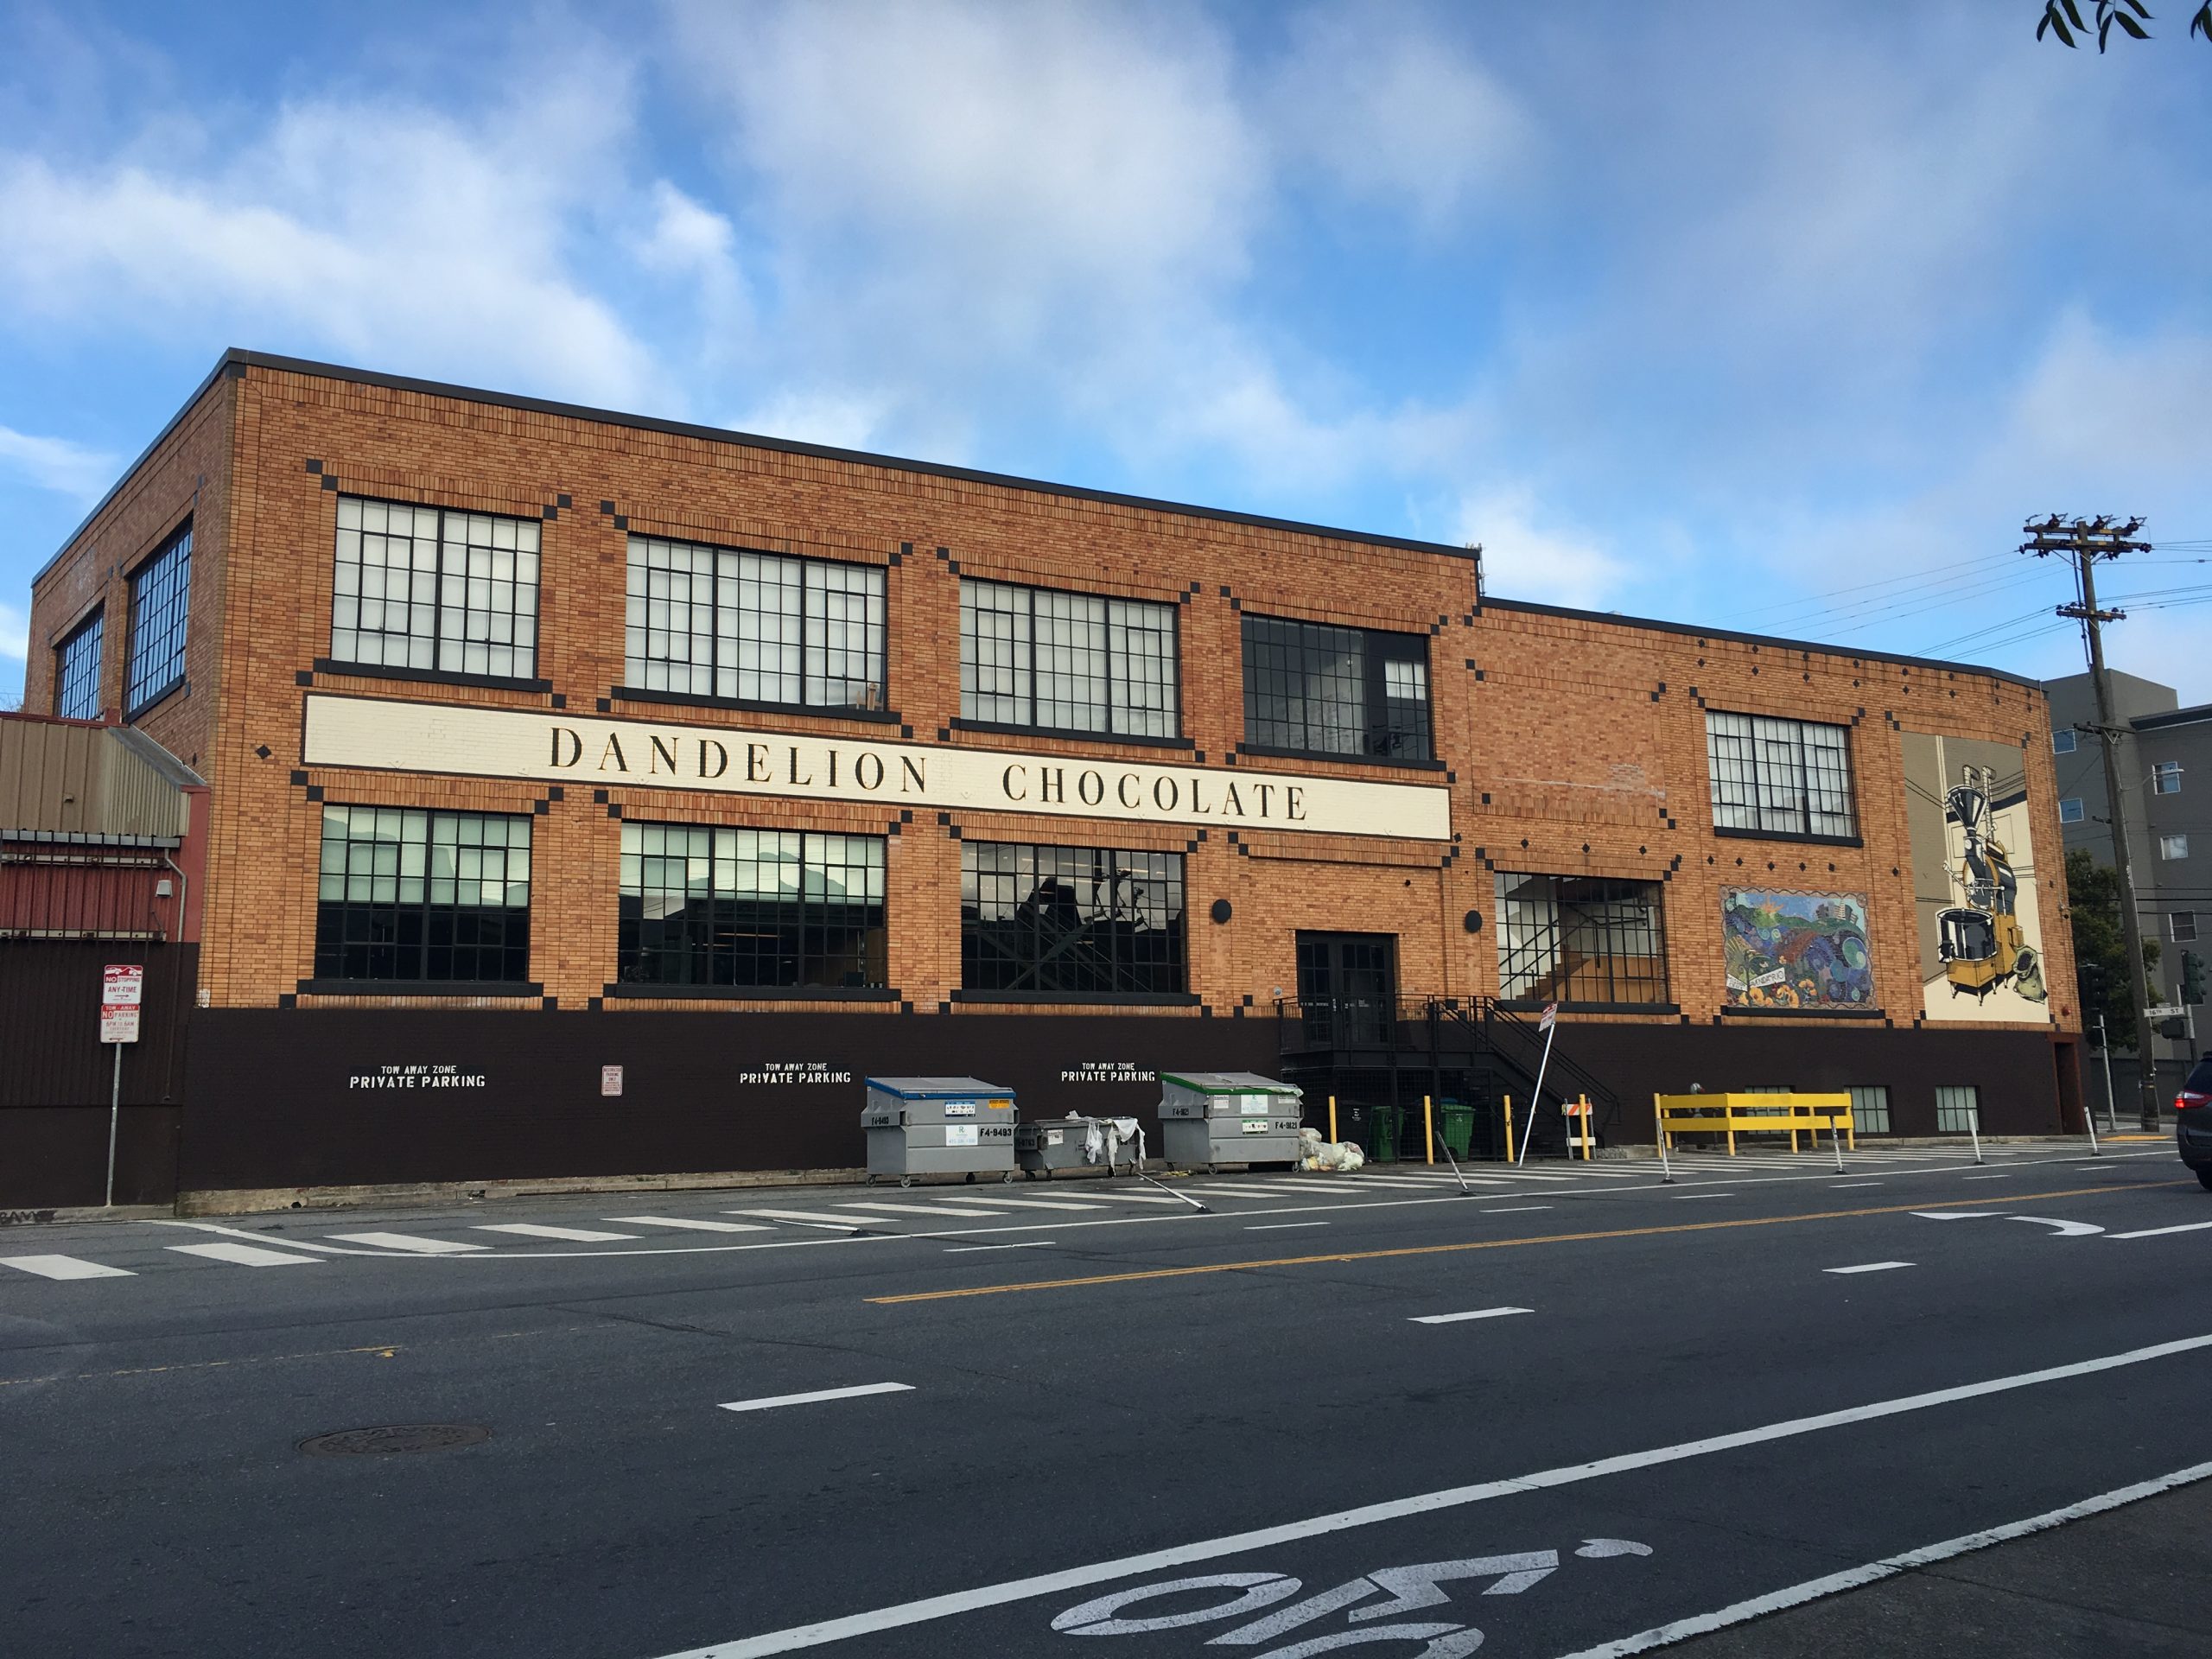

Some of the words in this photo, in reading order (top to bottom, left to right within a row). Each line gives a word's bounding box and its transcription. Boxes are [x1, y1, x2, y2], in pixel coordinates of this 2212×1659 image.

[550, 727, 927, 793] DANDELION
[1001, 764, 1307, 821] CHOCOLATE
[381, 1065, 400, 1075] TOW
[404, 1065, 429, 1075] AWAY
[432, 1065, 457, 1074] ZONE
[1082, 1062, 1096, 1071] TOW
[1097, 1062, 1116, 1071] AWAY
[1117, 1062, 1135, 1071] ZONE
[740, 1072, 793, 1084] PRIVATE
[798, 1071, 851, 1084] PARKING
[1061, 1071, 1106, 1082] PRIVATE
[1110, 1071, 1155, 1082] PARKING
[349, 1076, 416, 1089] PRIVATE
[422, 1075, 486, 1088] PARKING
[1274, 1121, 1298, 1129] F4-9121
[980, 1128, 1012, 1137] F4-9493
